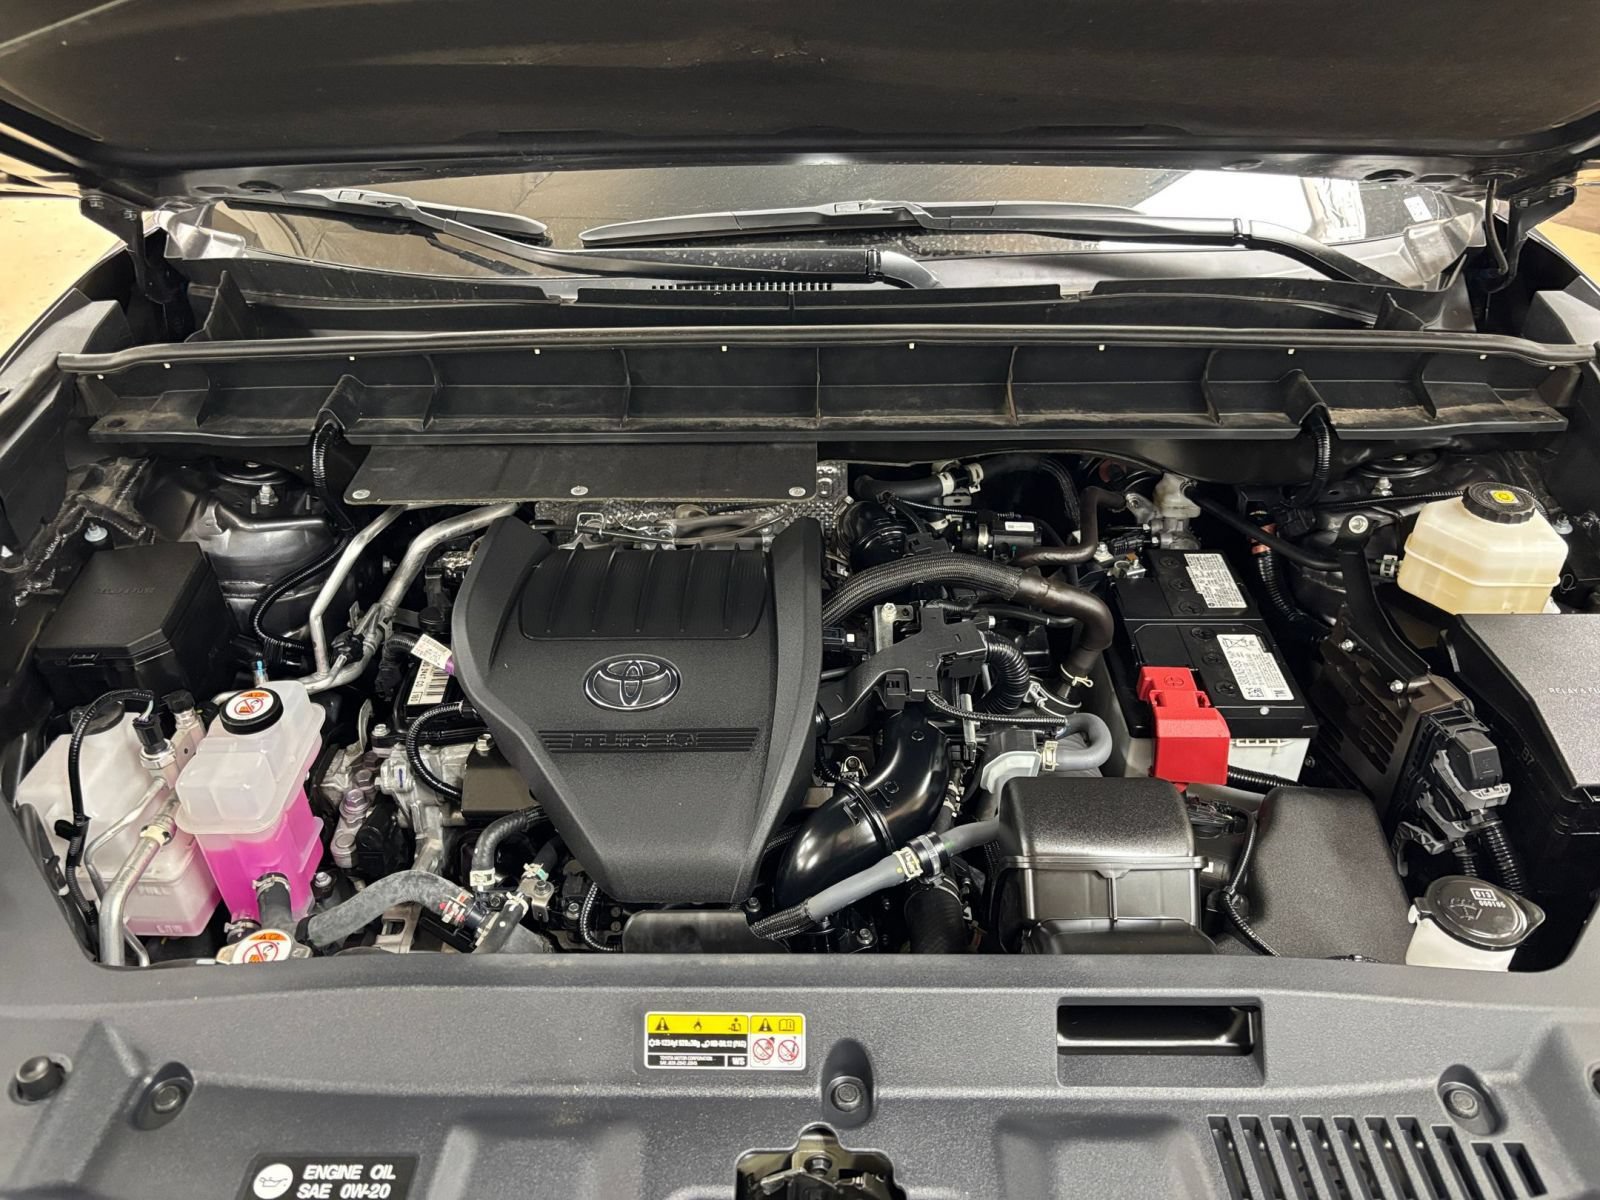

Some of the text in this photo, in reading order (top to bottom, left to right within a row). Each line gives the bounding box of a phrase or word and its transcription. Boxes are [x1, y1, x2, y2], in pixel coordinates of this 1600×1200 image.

[1548, 687, 1578, 695] RELAY
[573, 731, 696, 748] TURBO
[731, 1057, 746, 1066] WS
[302, 1164, 396, 1180] ENGINE OIL
[296, 1183, 391, 1199] SAE 0W-20
